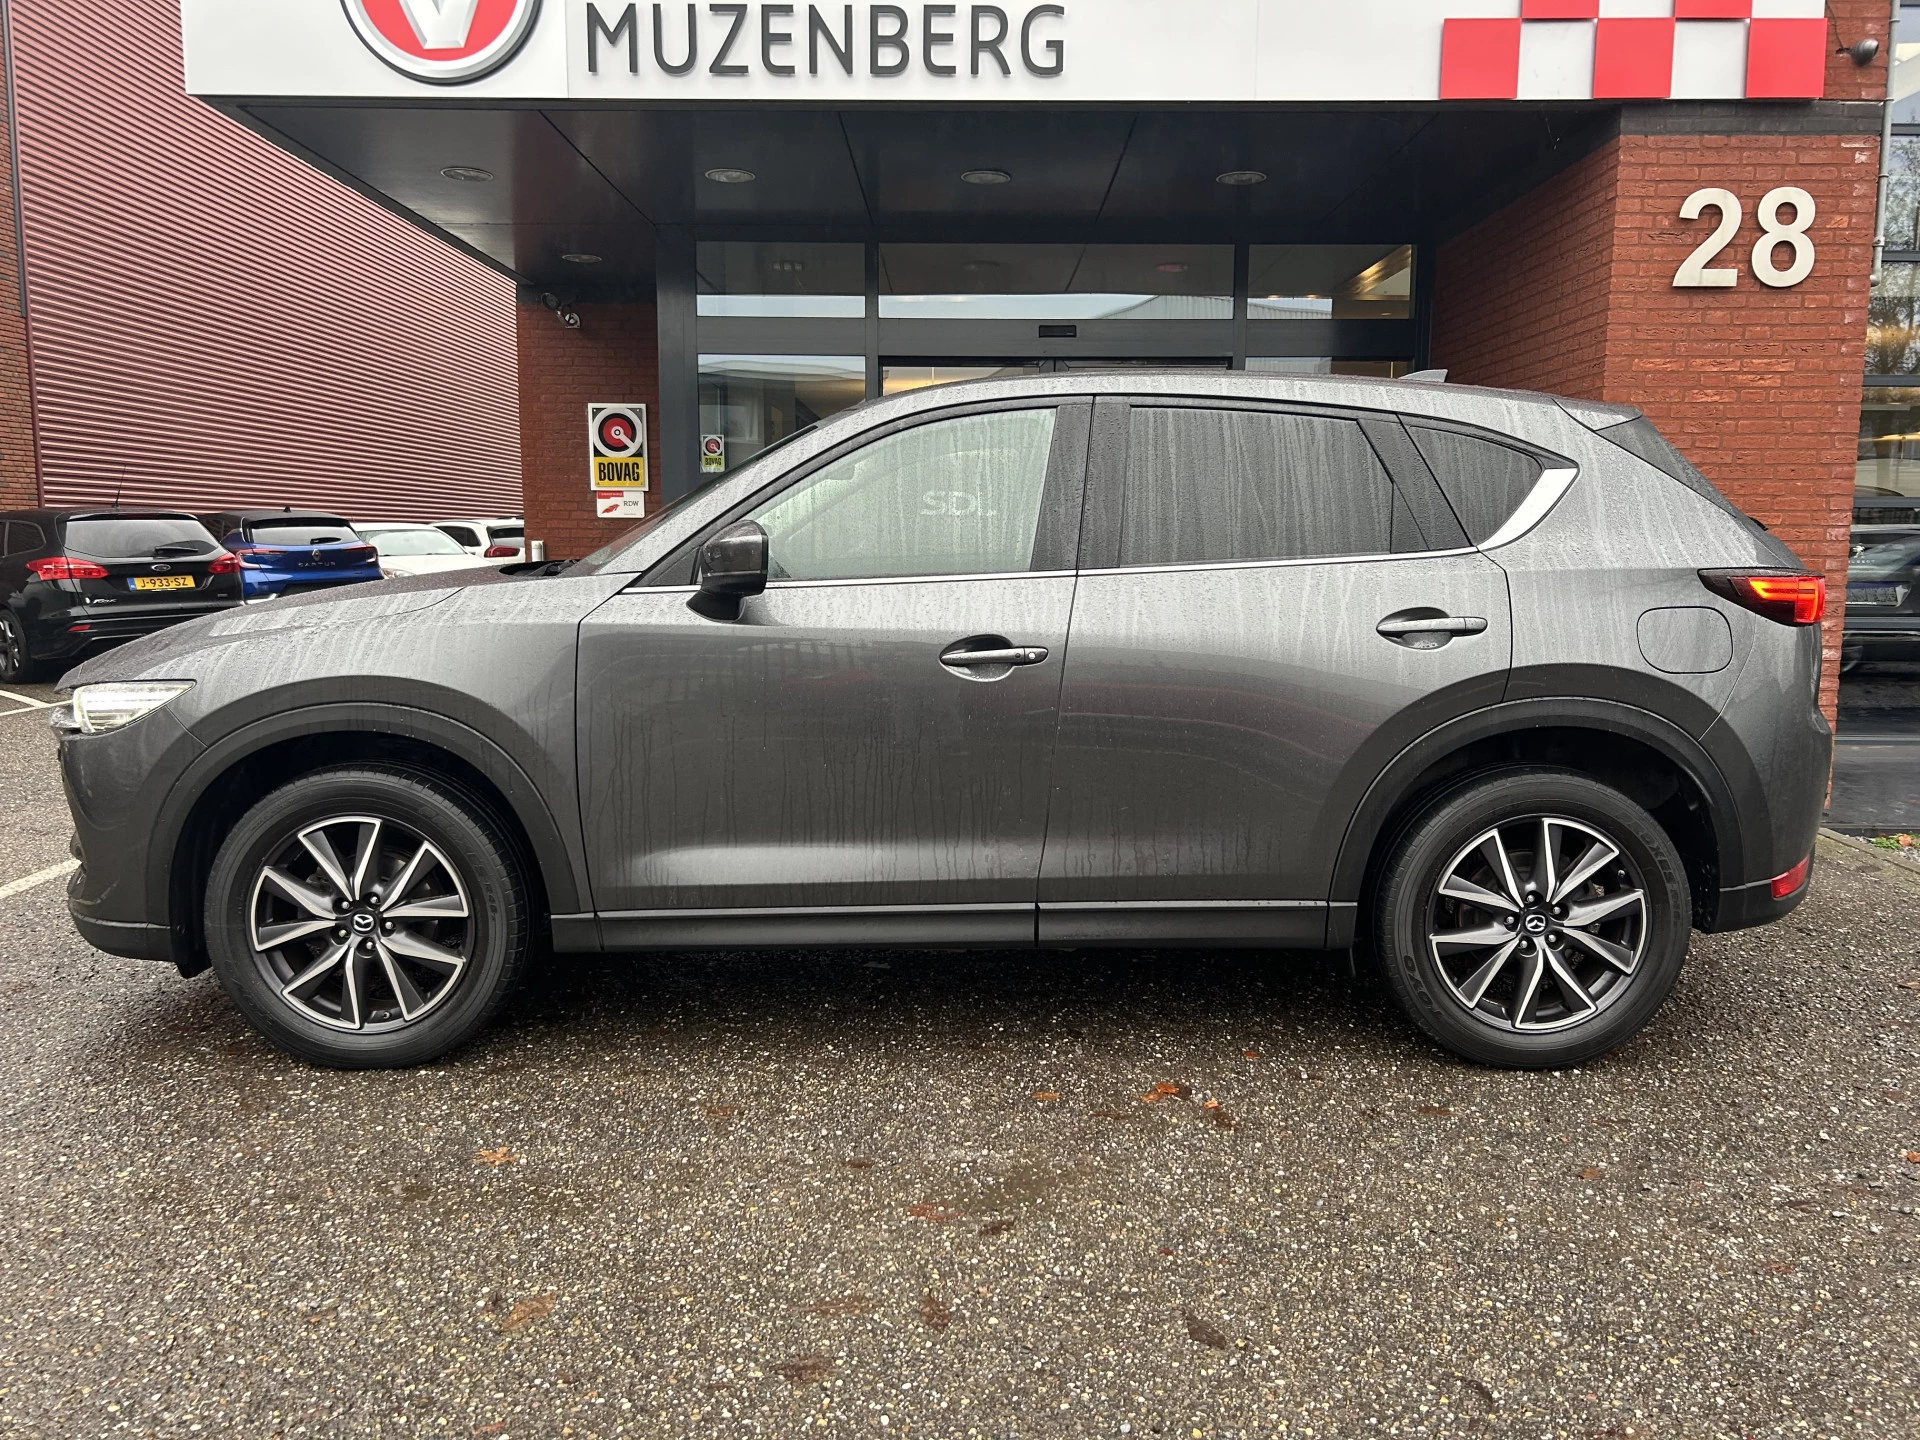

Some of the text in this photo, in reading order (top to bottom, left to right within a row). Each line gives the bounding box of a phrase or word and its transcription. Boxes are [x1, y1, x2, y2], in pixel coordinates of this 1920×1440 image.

[586, 3, 1065, 76] MUZENBERG
[1672, 186, 1816, 288] 28
[598, 461, 640, 482] BOVAG
[140, 577, 189, 588] J-933-SZ
